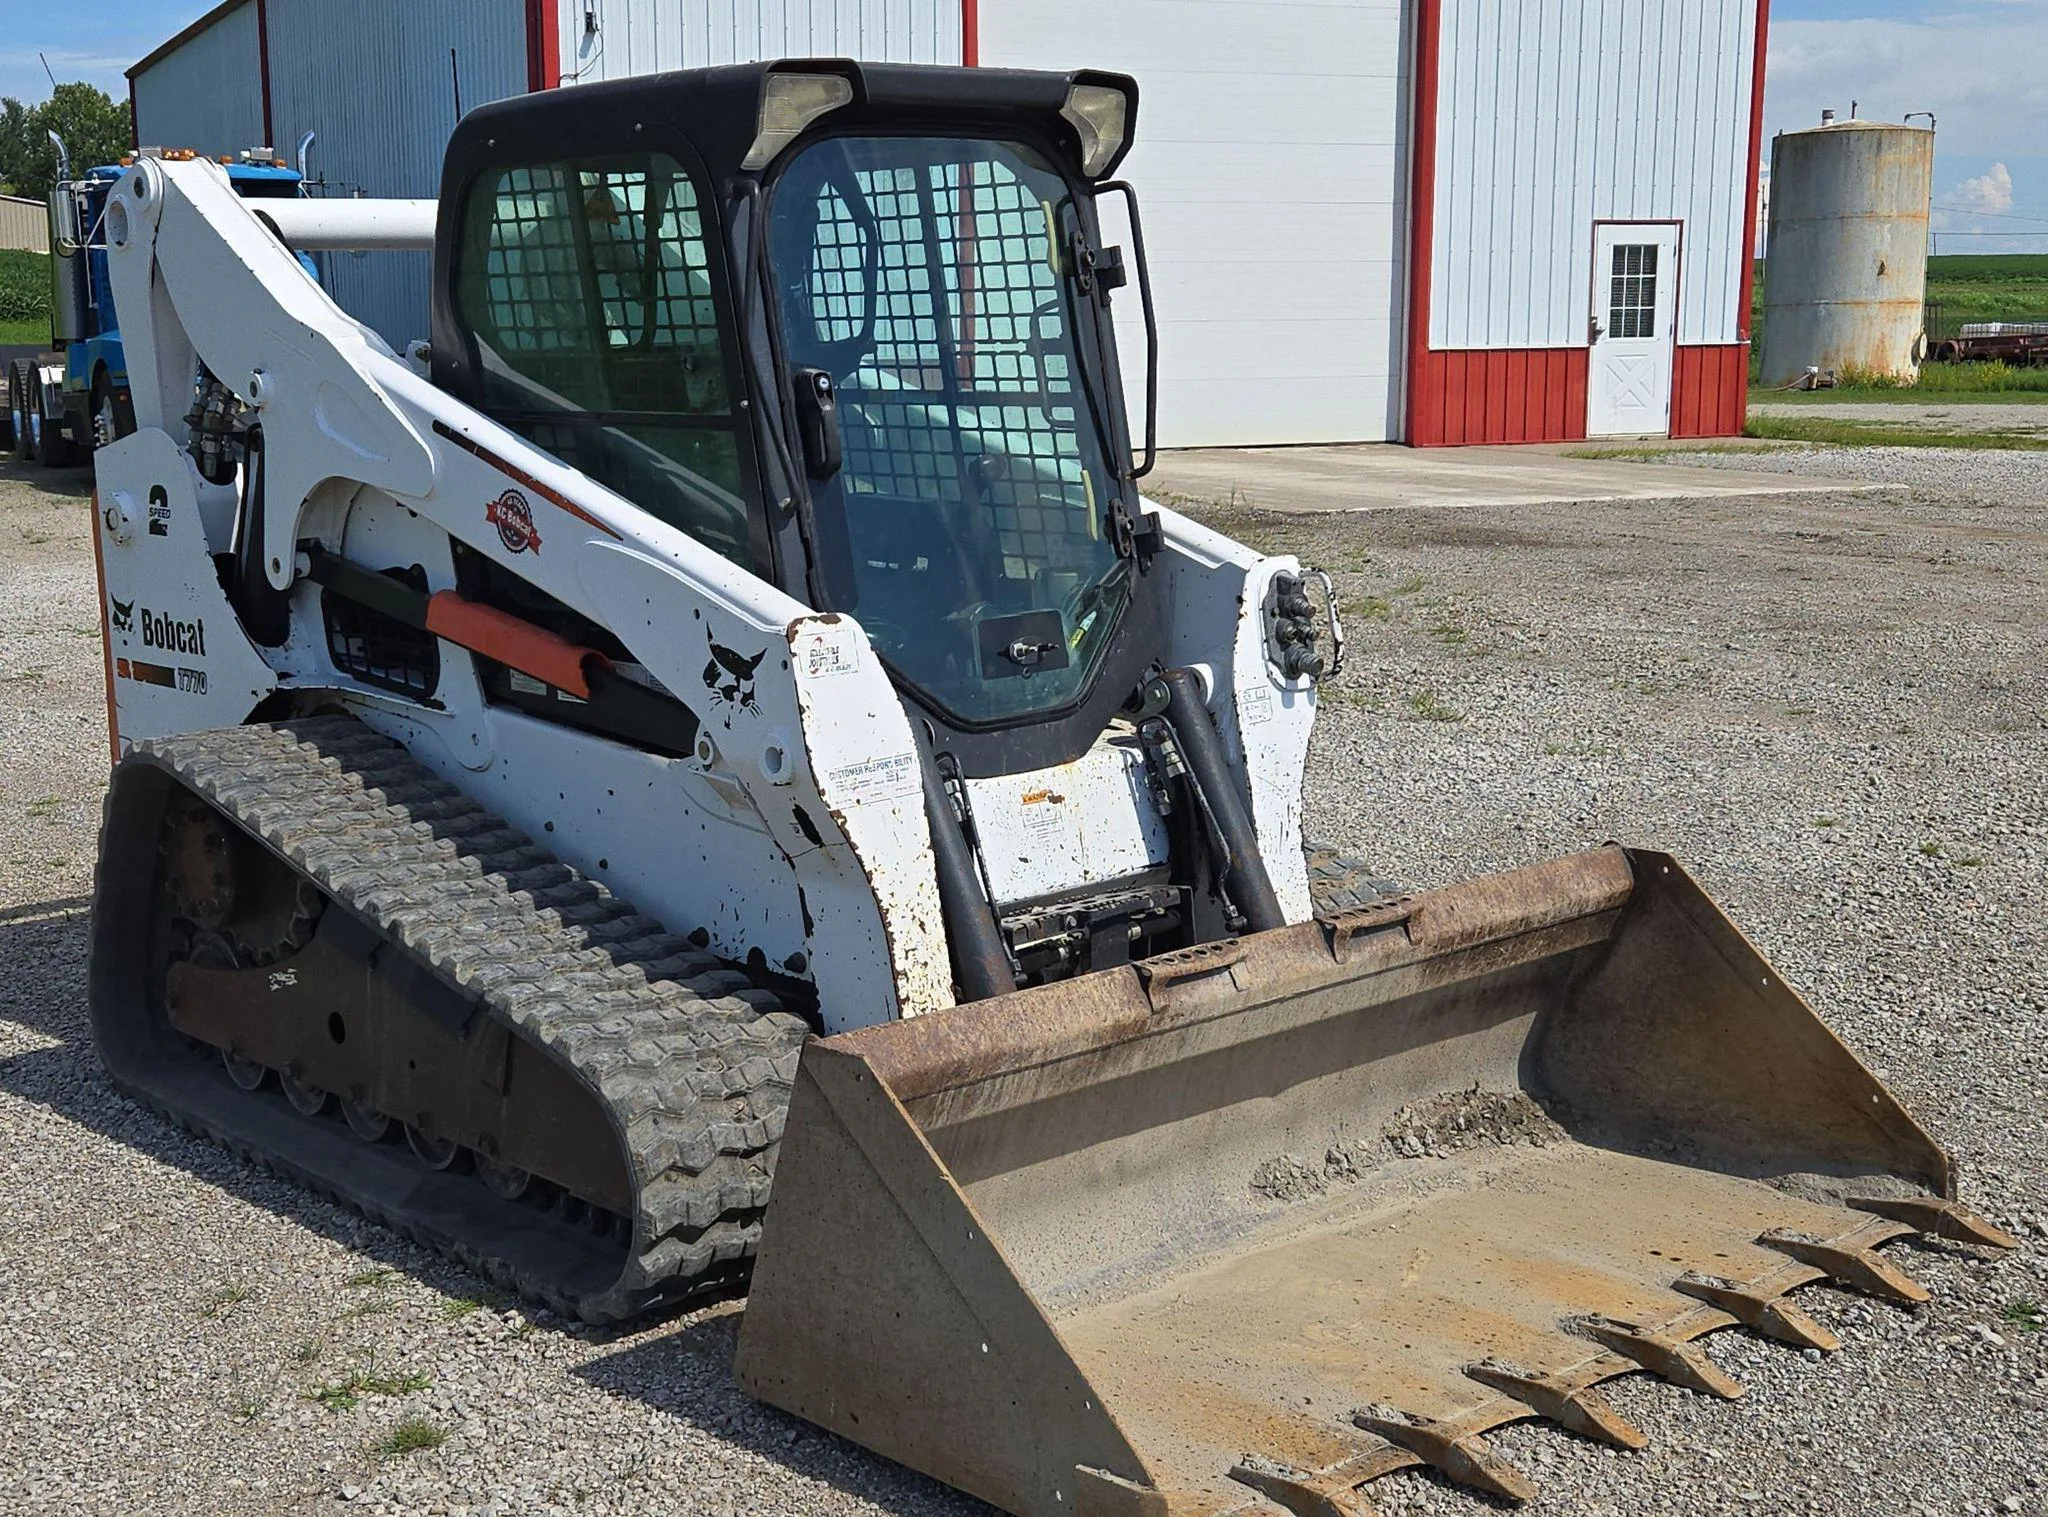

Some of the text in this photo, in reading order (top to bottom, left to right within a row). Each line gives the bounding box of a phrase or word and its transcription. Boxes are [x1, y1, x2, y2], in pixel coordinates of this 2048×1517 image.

[149, 507, 171, 519] SPEED
[141, 608, 206, 656] Bobcat
[829, 766, 863, 781] CUSTOMER
